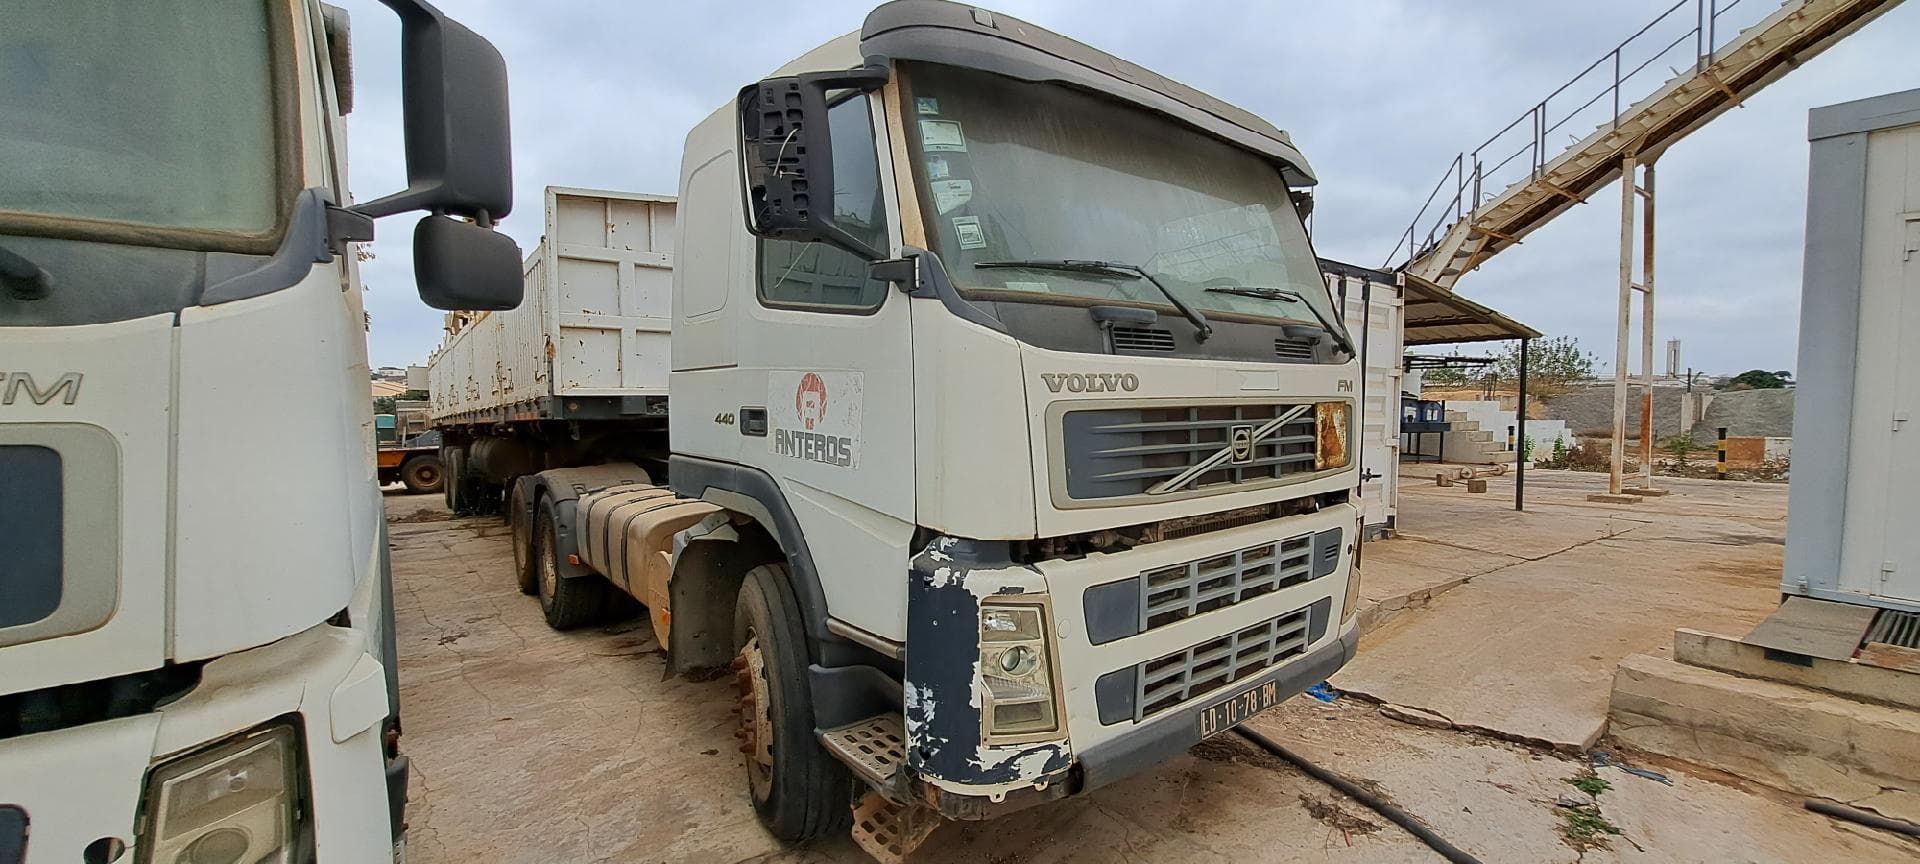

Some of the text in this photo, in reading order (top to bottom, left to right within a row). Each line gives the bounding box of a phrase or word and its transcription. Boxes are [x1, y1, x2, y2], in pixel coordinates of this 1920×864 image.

[1041, 373, 1139, 393] VOLVO
[1338, 380, 1353, 392] FM
[714, 413, 736, 425] 440
[775, 428, 852, 467] ANTEROS
